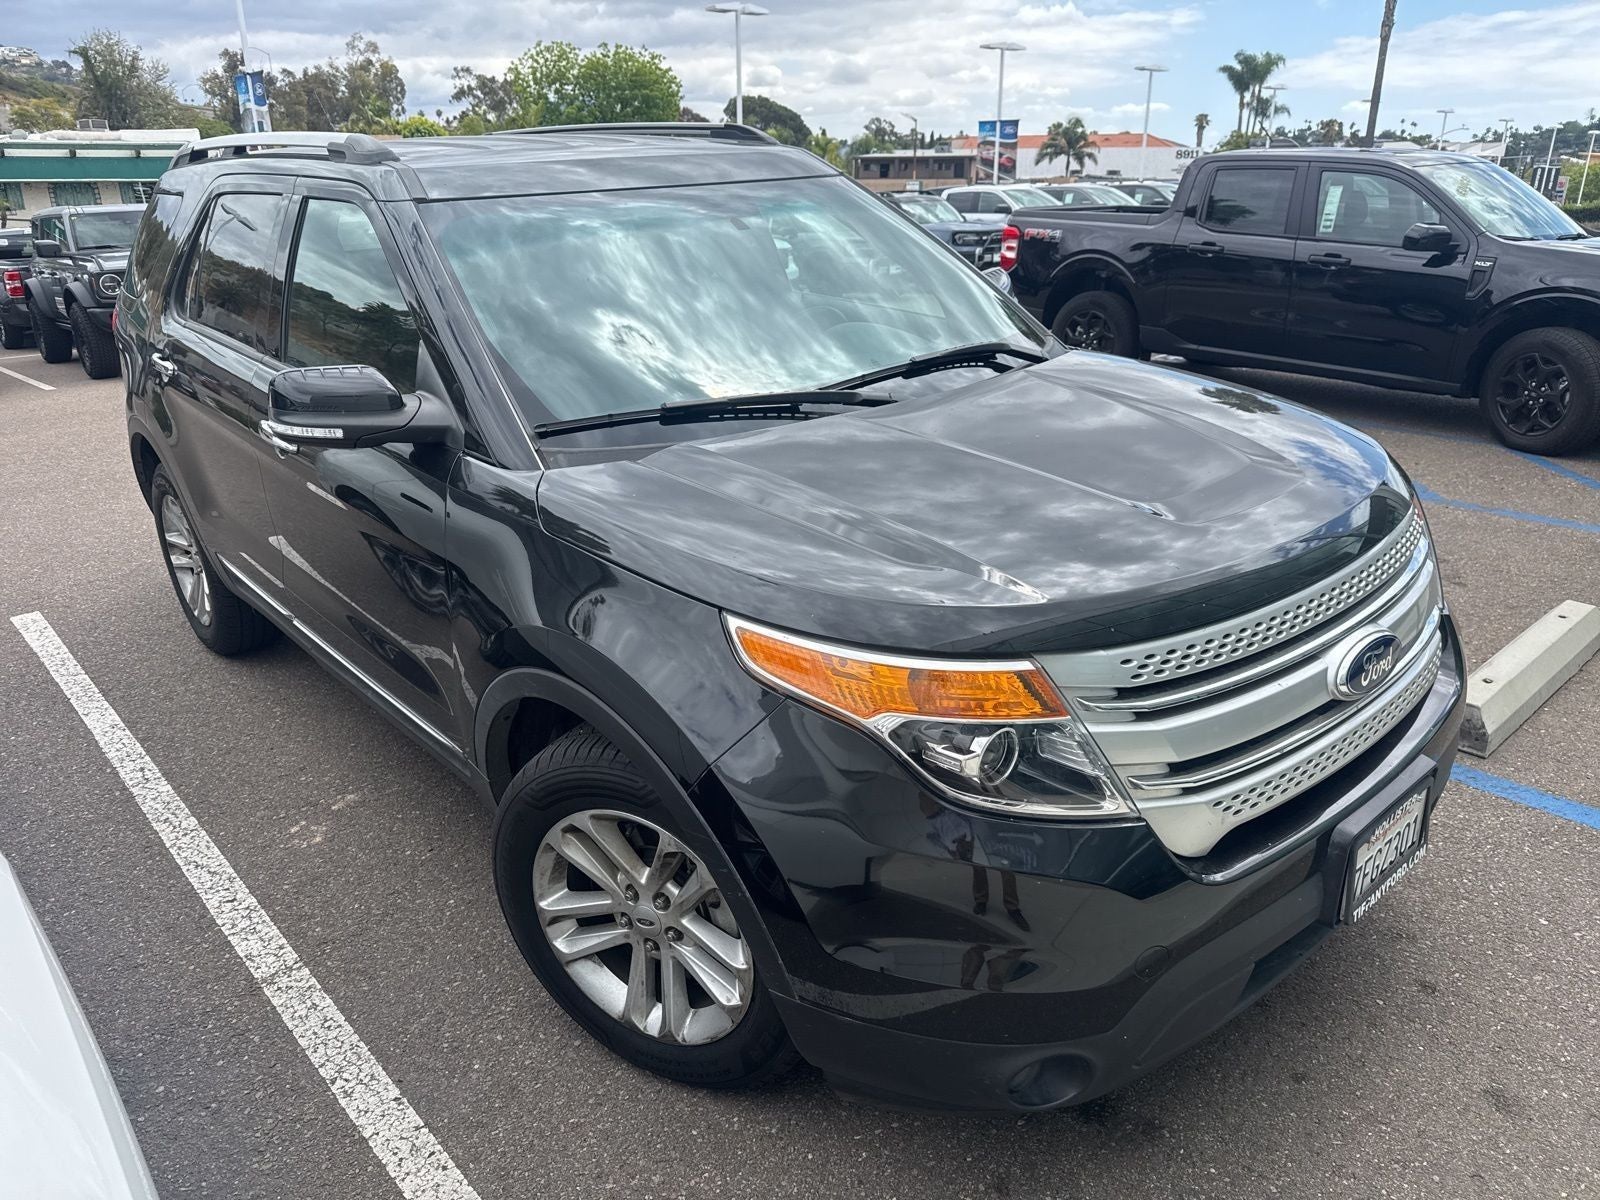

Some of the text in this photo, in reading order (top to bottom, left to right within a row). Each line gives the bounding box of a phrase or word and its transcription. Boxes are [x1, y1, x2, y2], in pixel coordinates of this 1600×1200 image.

[1175, 149, 1200, 159] 8911
[1024, 228, 1063, 242] FX4
[1361, 645, 1393, 687] Ford
[1353, 813, 1419, 901] 7FGZ301
[1352, 843, 1427, 923] TIFFANYFORD.COM
